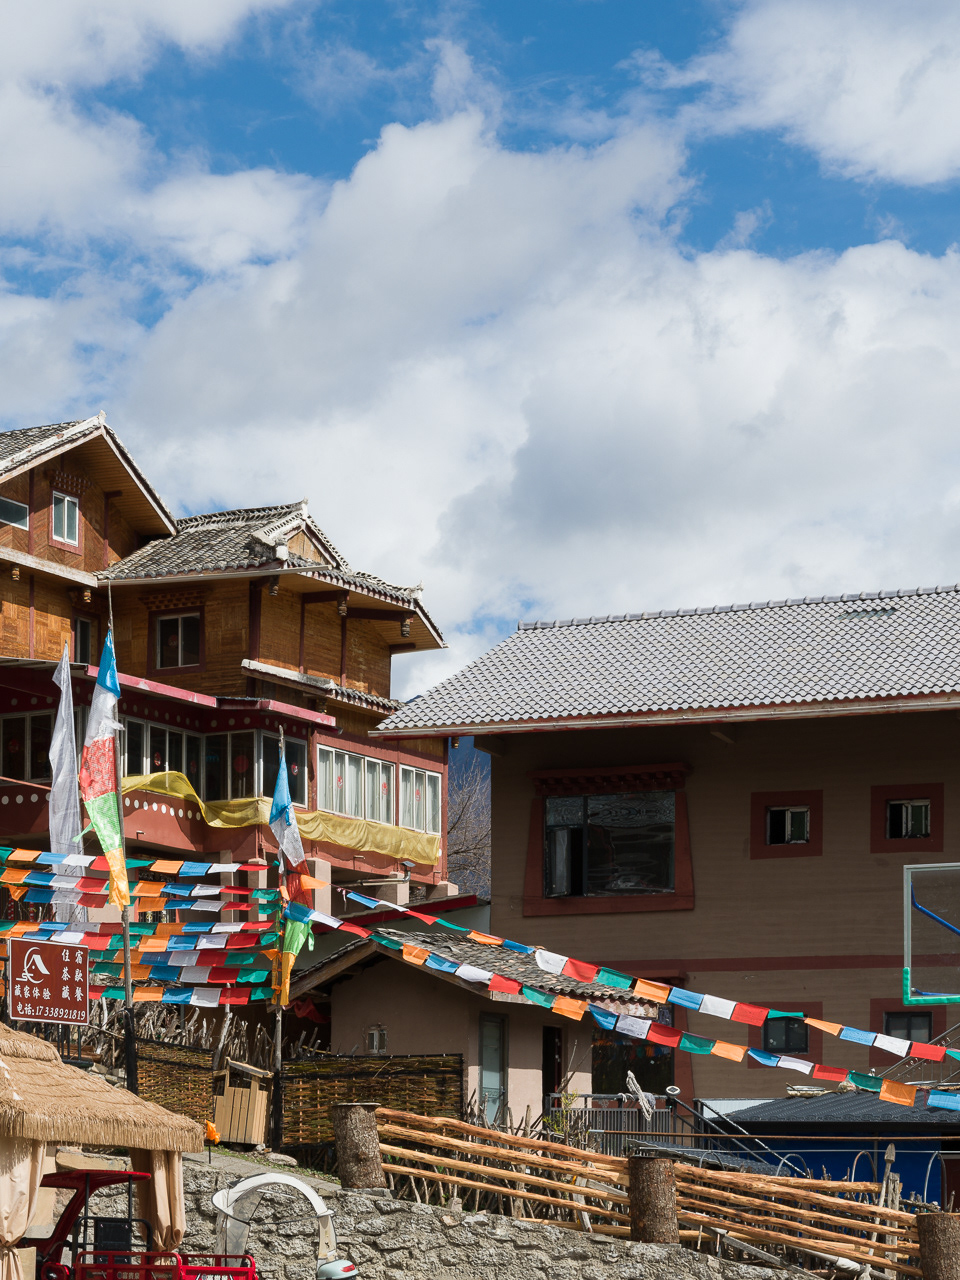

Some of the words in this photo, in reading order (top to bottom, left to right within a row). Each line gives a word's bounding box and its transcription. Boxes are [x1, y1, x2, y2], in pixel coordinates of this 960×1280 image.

[61, 949, 84, 964] 住宿
[14, 984, 52, 1000] 藏家体验
[61, 985, 84, 1002] 藏餐
